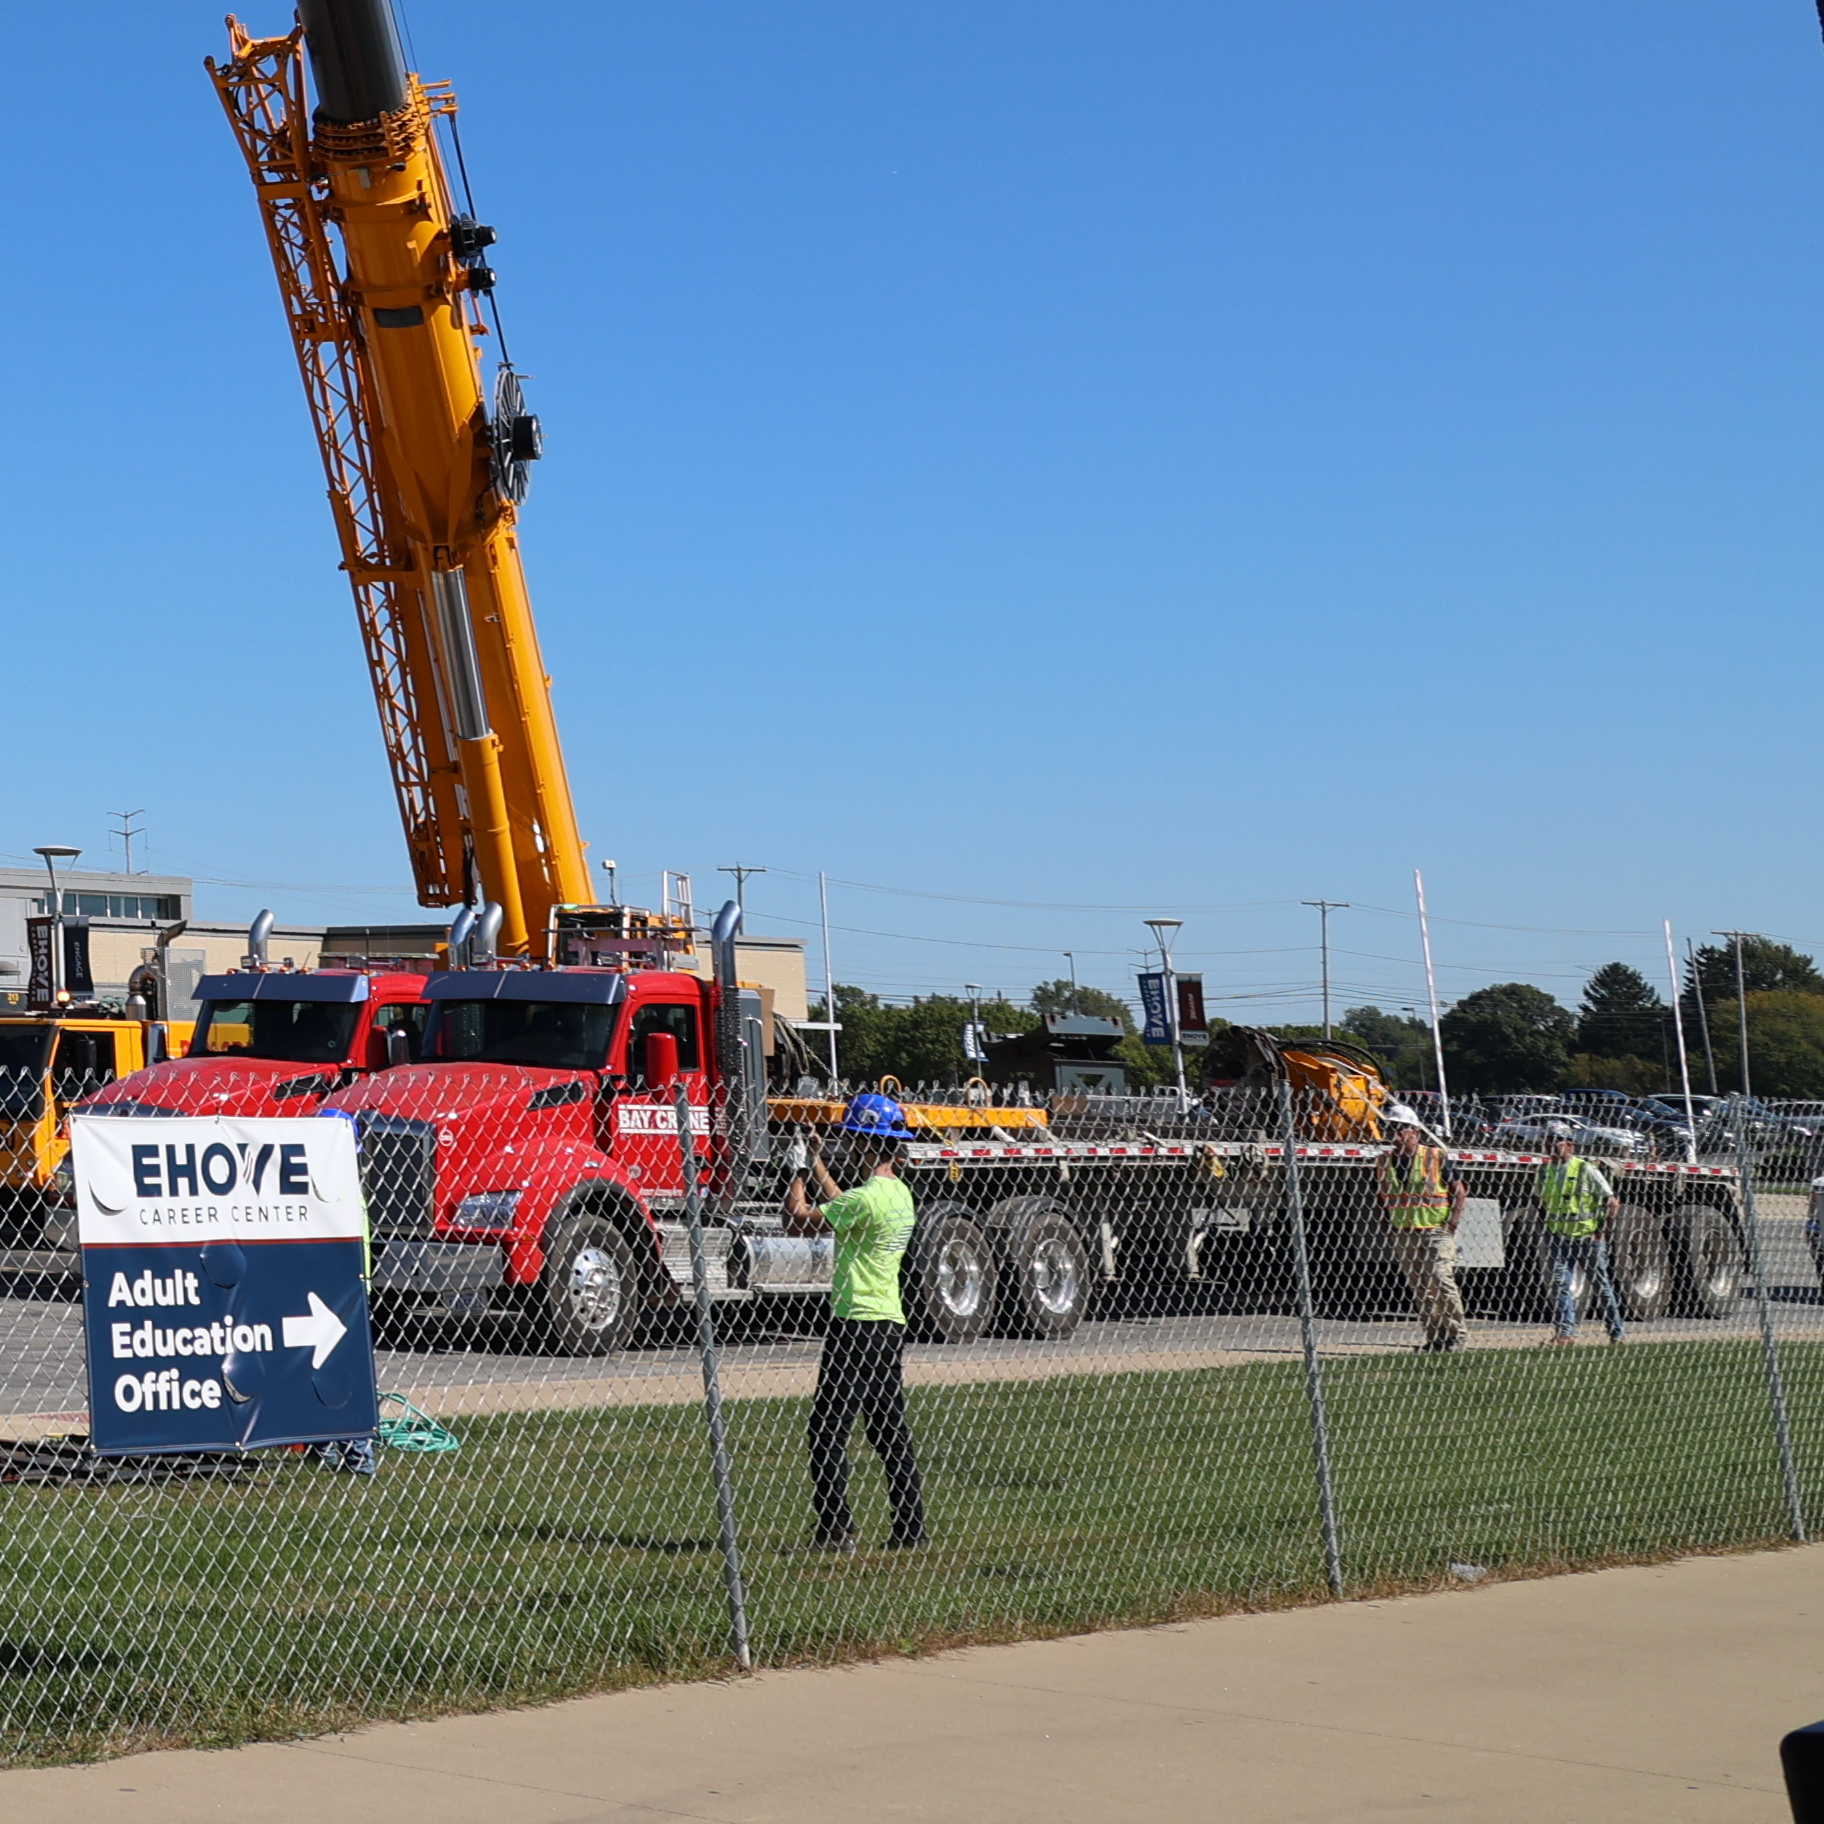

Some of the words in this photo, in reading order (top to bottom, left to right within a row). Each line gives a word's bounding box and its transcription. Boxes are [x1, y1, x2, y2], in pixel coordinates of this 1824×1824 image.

[36, 925, 50, 1002] EHOVE
[73, 941, 84, 979] ENGAGE
[1147, 978, 1165, 1038] EHOVE
[618, 1109, 652, 1129] BAY
[656, 1110, 711, 1130] CRNE
[131, 1142, 310, 1198] EHOVE
[139, 1206, 219, 1226] CAREER
[232, 1205, 309, 1223] CENTER
[108, 1269, 200, 1308] Adult
[111, 1315, 274, 1359] Education
[114, 1368, 223, 1413] Office
